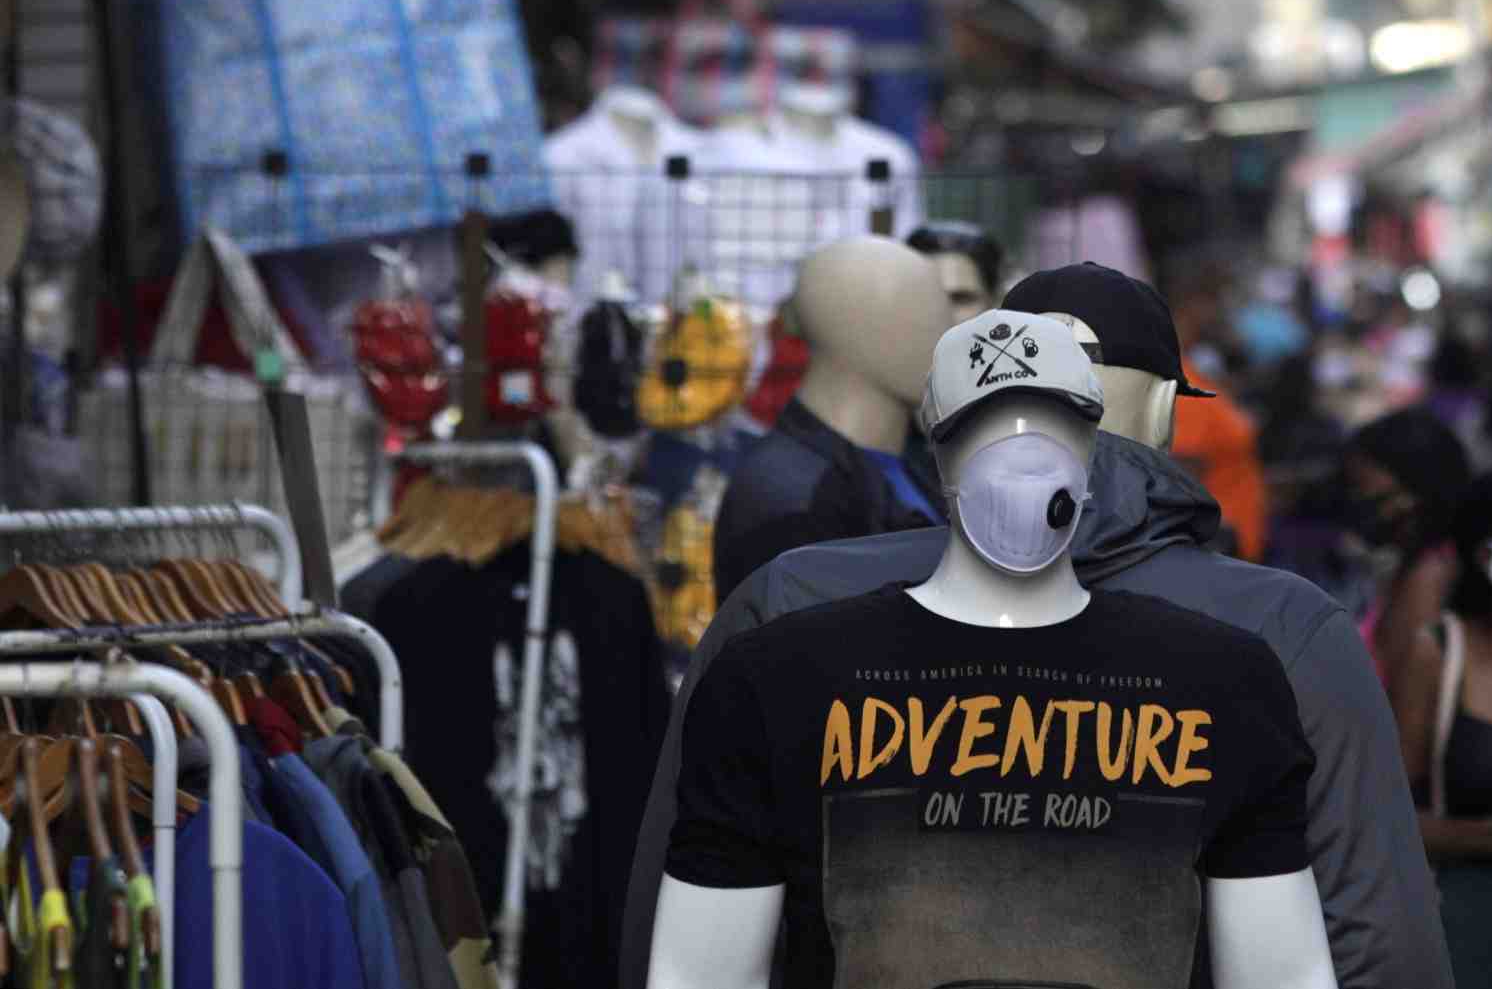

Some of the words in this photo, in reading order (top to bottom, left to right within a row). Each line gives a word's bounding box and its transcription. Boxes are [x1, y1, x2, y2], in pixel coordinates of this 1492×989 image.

[856, 667, 911, 681] ACROSS
[920, 663, 982, 679] AMERICA
[993, 662, 1008, 676] IN
[1018, 665, 1067, 681] SEARCH
[1076, 672, 1090, 684] OF
[1100, 675, 1162, 688] FREEDOM
[819, 695, 1212, 788] ADVENTURE
[925, 792, 966, 825] ON
[980, 792, 1030, 827] THE
[1043, 793, 1111, 828] ROAD
